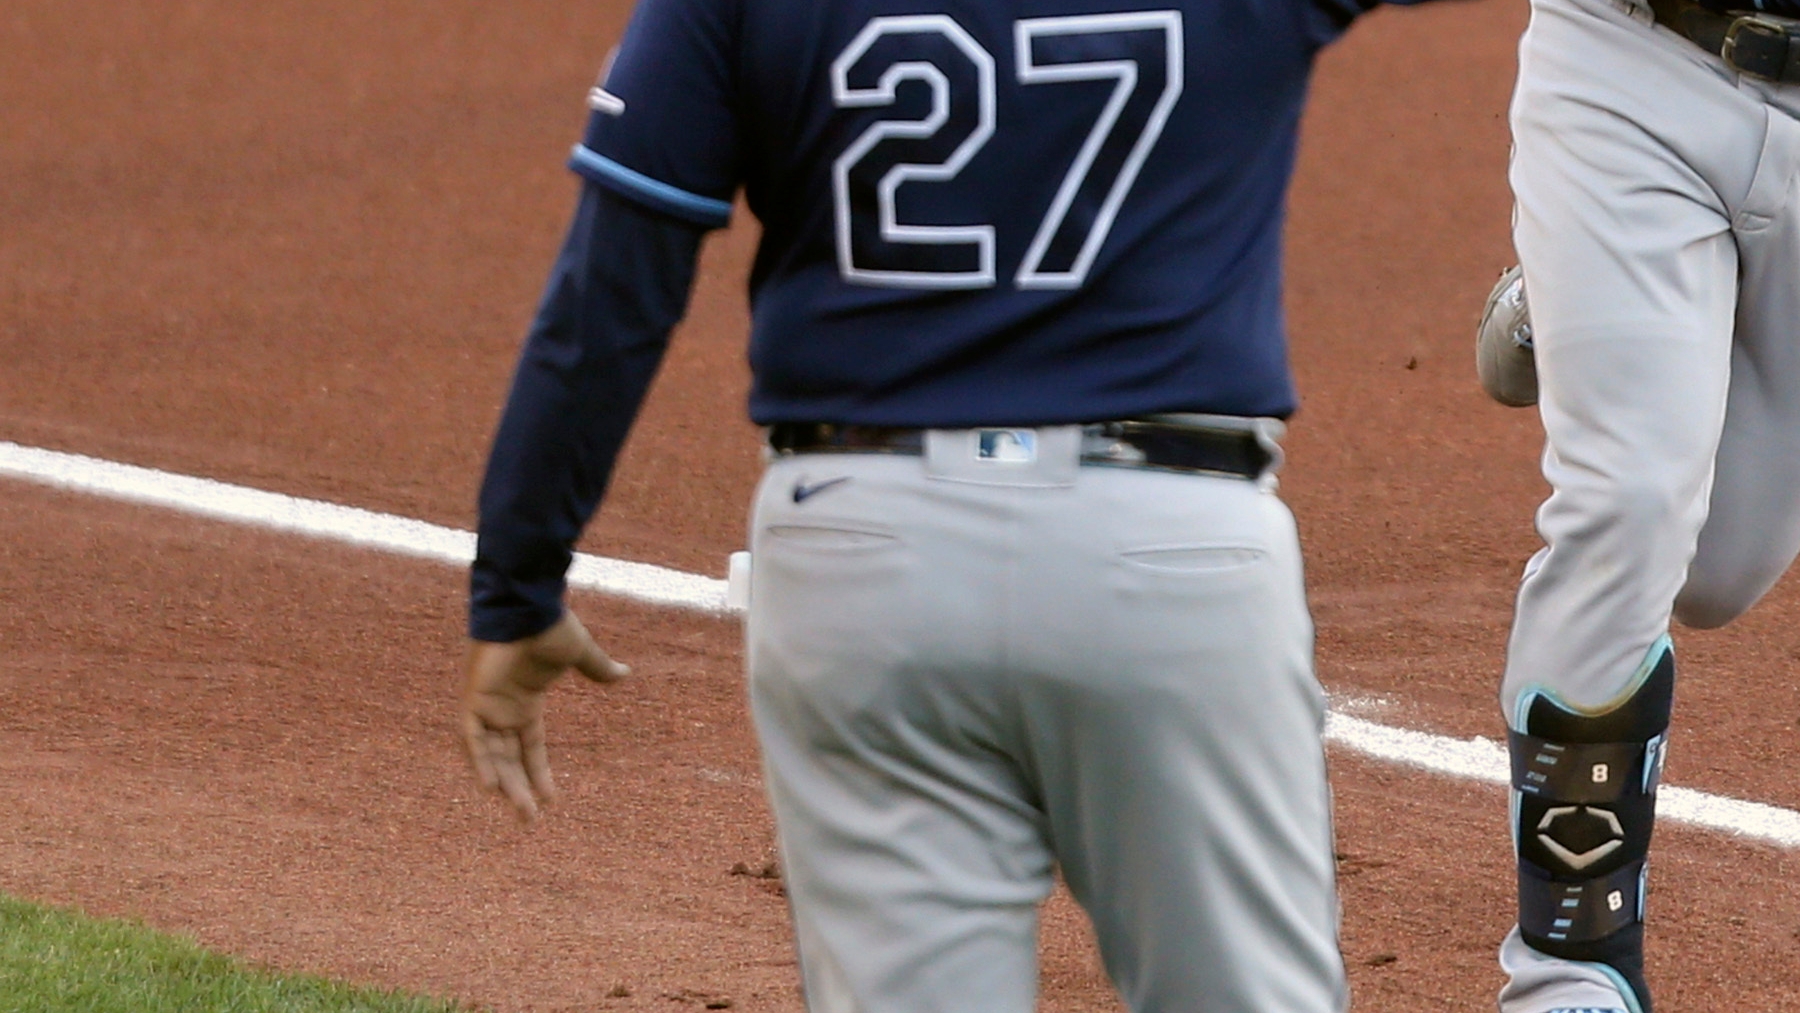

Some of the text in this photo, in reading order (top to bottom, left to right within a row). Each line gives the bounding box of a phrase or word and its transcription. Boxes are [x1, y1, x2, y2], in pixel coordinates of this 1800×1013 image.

[830, 10, 1184, 288] 27
[1593, 764, 1608, 783] 8
[1608, 891, 1623, 911] 8
